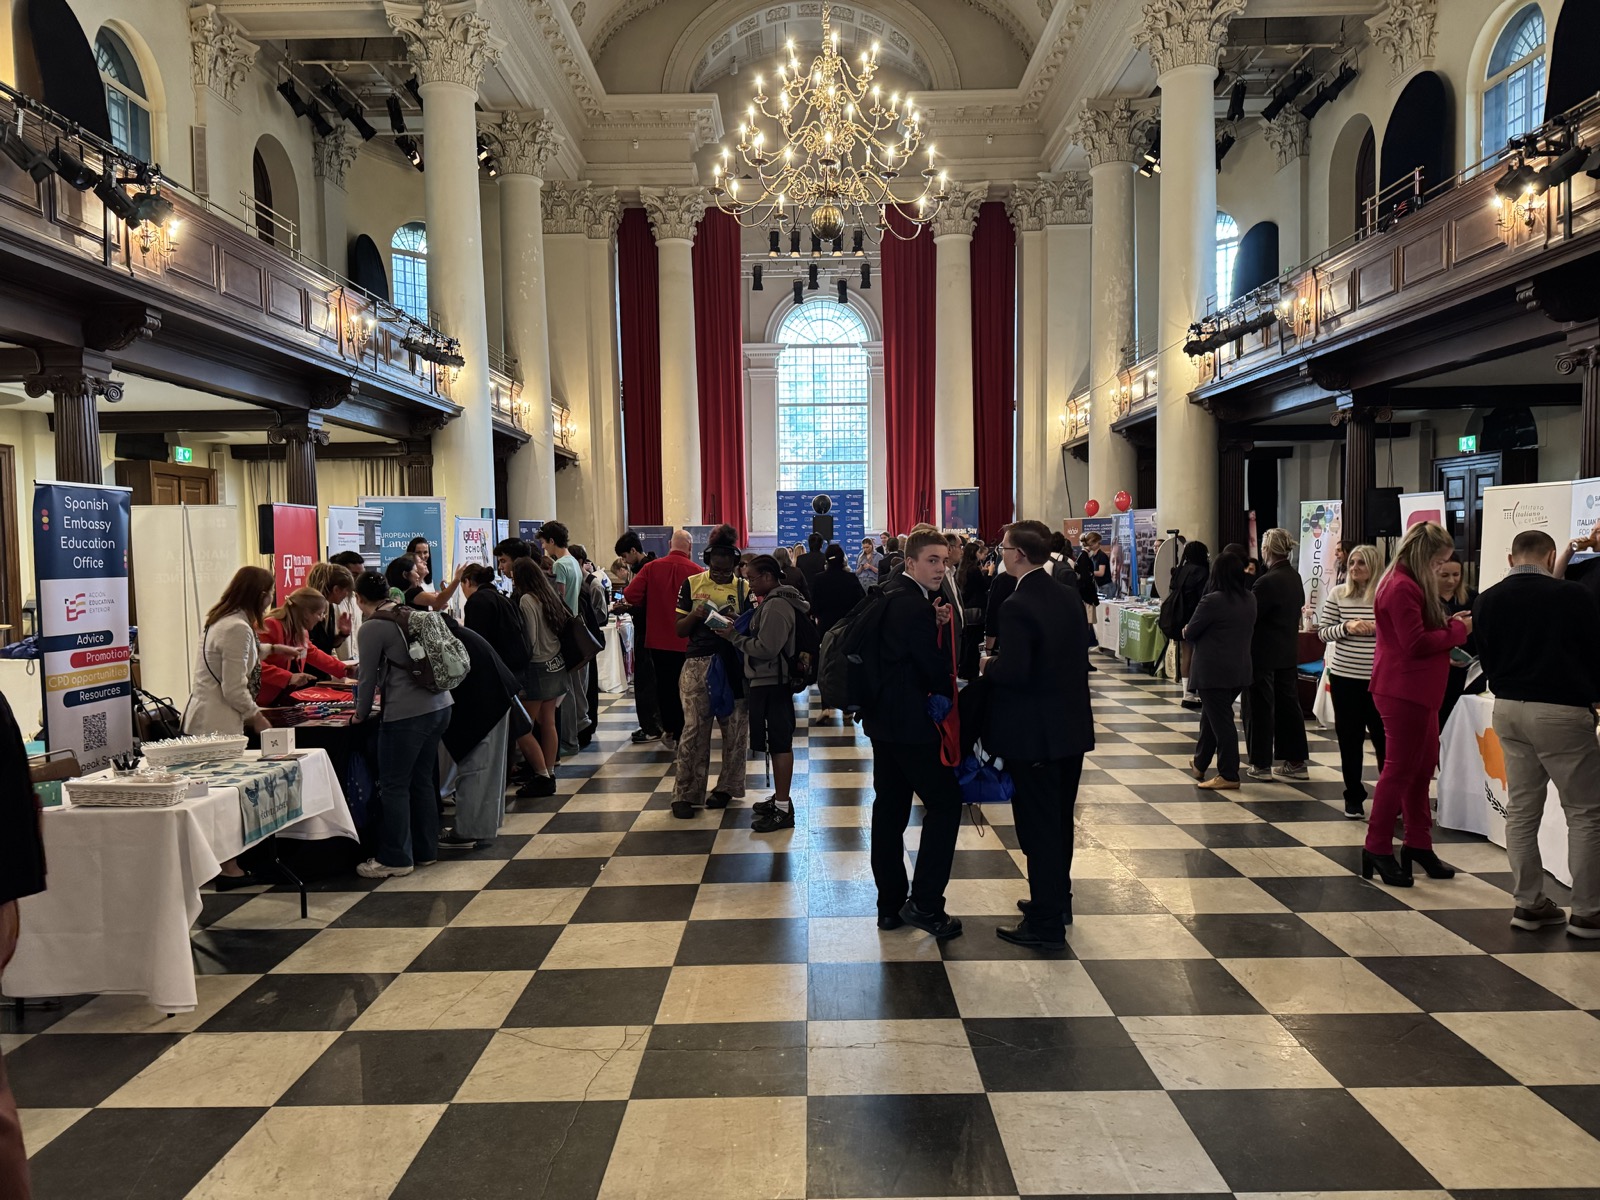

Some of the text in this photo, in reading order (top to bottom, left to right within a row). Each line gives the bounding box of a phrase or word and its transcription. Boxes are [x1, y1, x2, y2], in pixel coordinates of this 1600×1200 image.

[64, 496, 109, 512] Spanish
[63, 515, 112, 533] Embassy
[60, 536, 115, 550] Education
[73, 556, 104, 569] Office
[1310, 538, 1323, 609] imagine
[88, 598, 115, 606] EDUCATIVA
[89, 606, 111, 614] EXTERIOR
[76, 633, 104, 646] Advice
[85, 649, 128, 663] Promotion
[48, 667, 128, 689] CPD opportunities
[79, 686, 121, 701] Resources
[80, 757, 101, 773] peak
